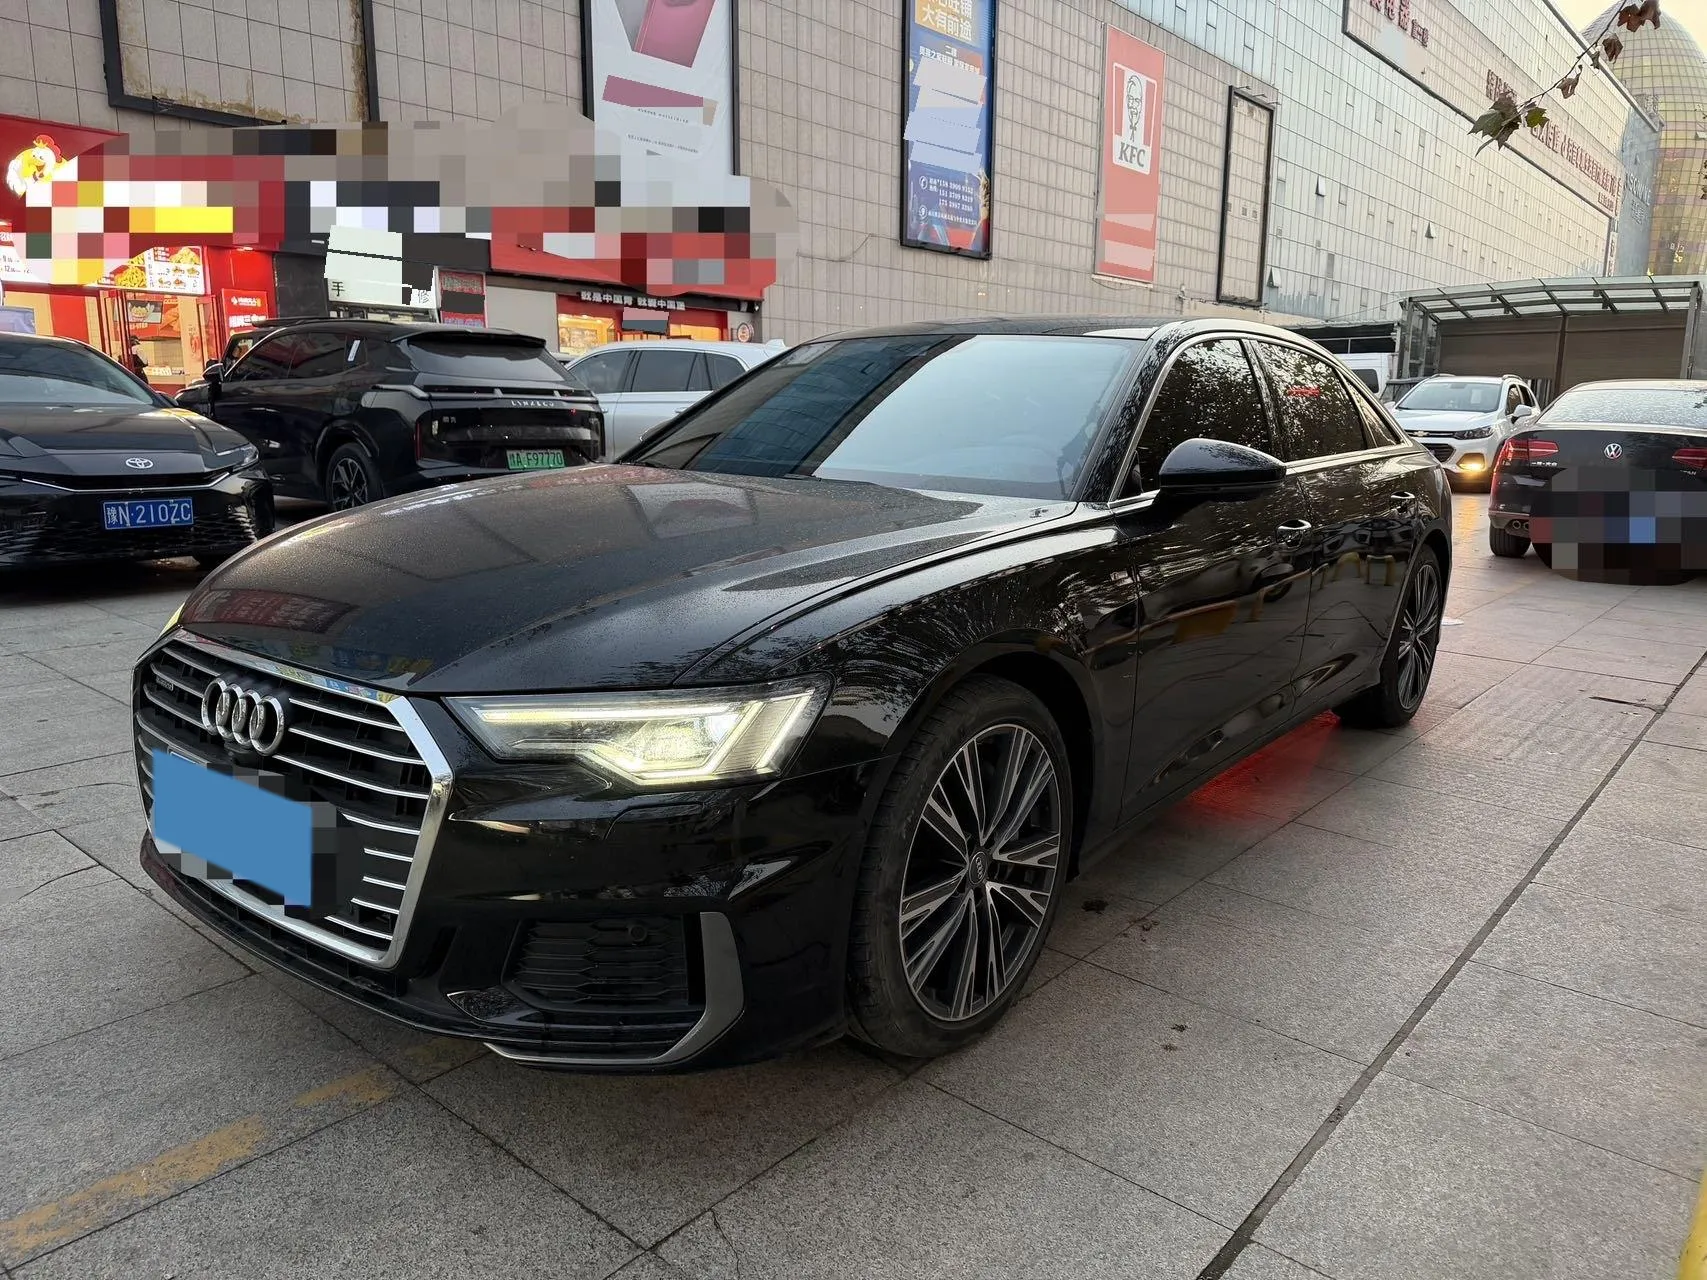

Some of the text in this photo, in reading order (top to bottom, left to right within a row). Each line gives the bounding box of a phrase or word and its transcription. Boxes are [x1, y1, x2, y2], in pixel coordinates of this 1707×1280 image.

[922, 4, 972, 41] 大有前途
[1118, 146, 1146, 168] KFC
[331, 281, 345, 297] 手
